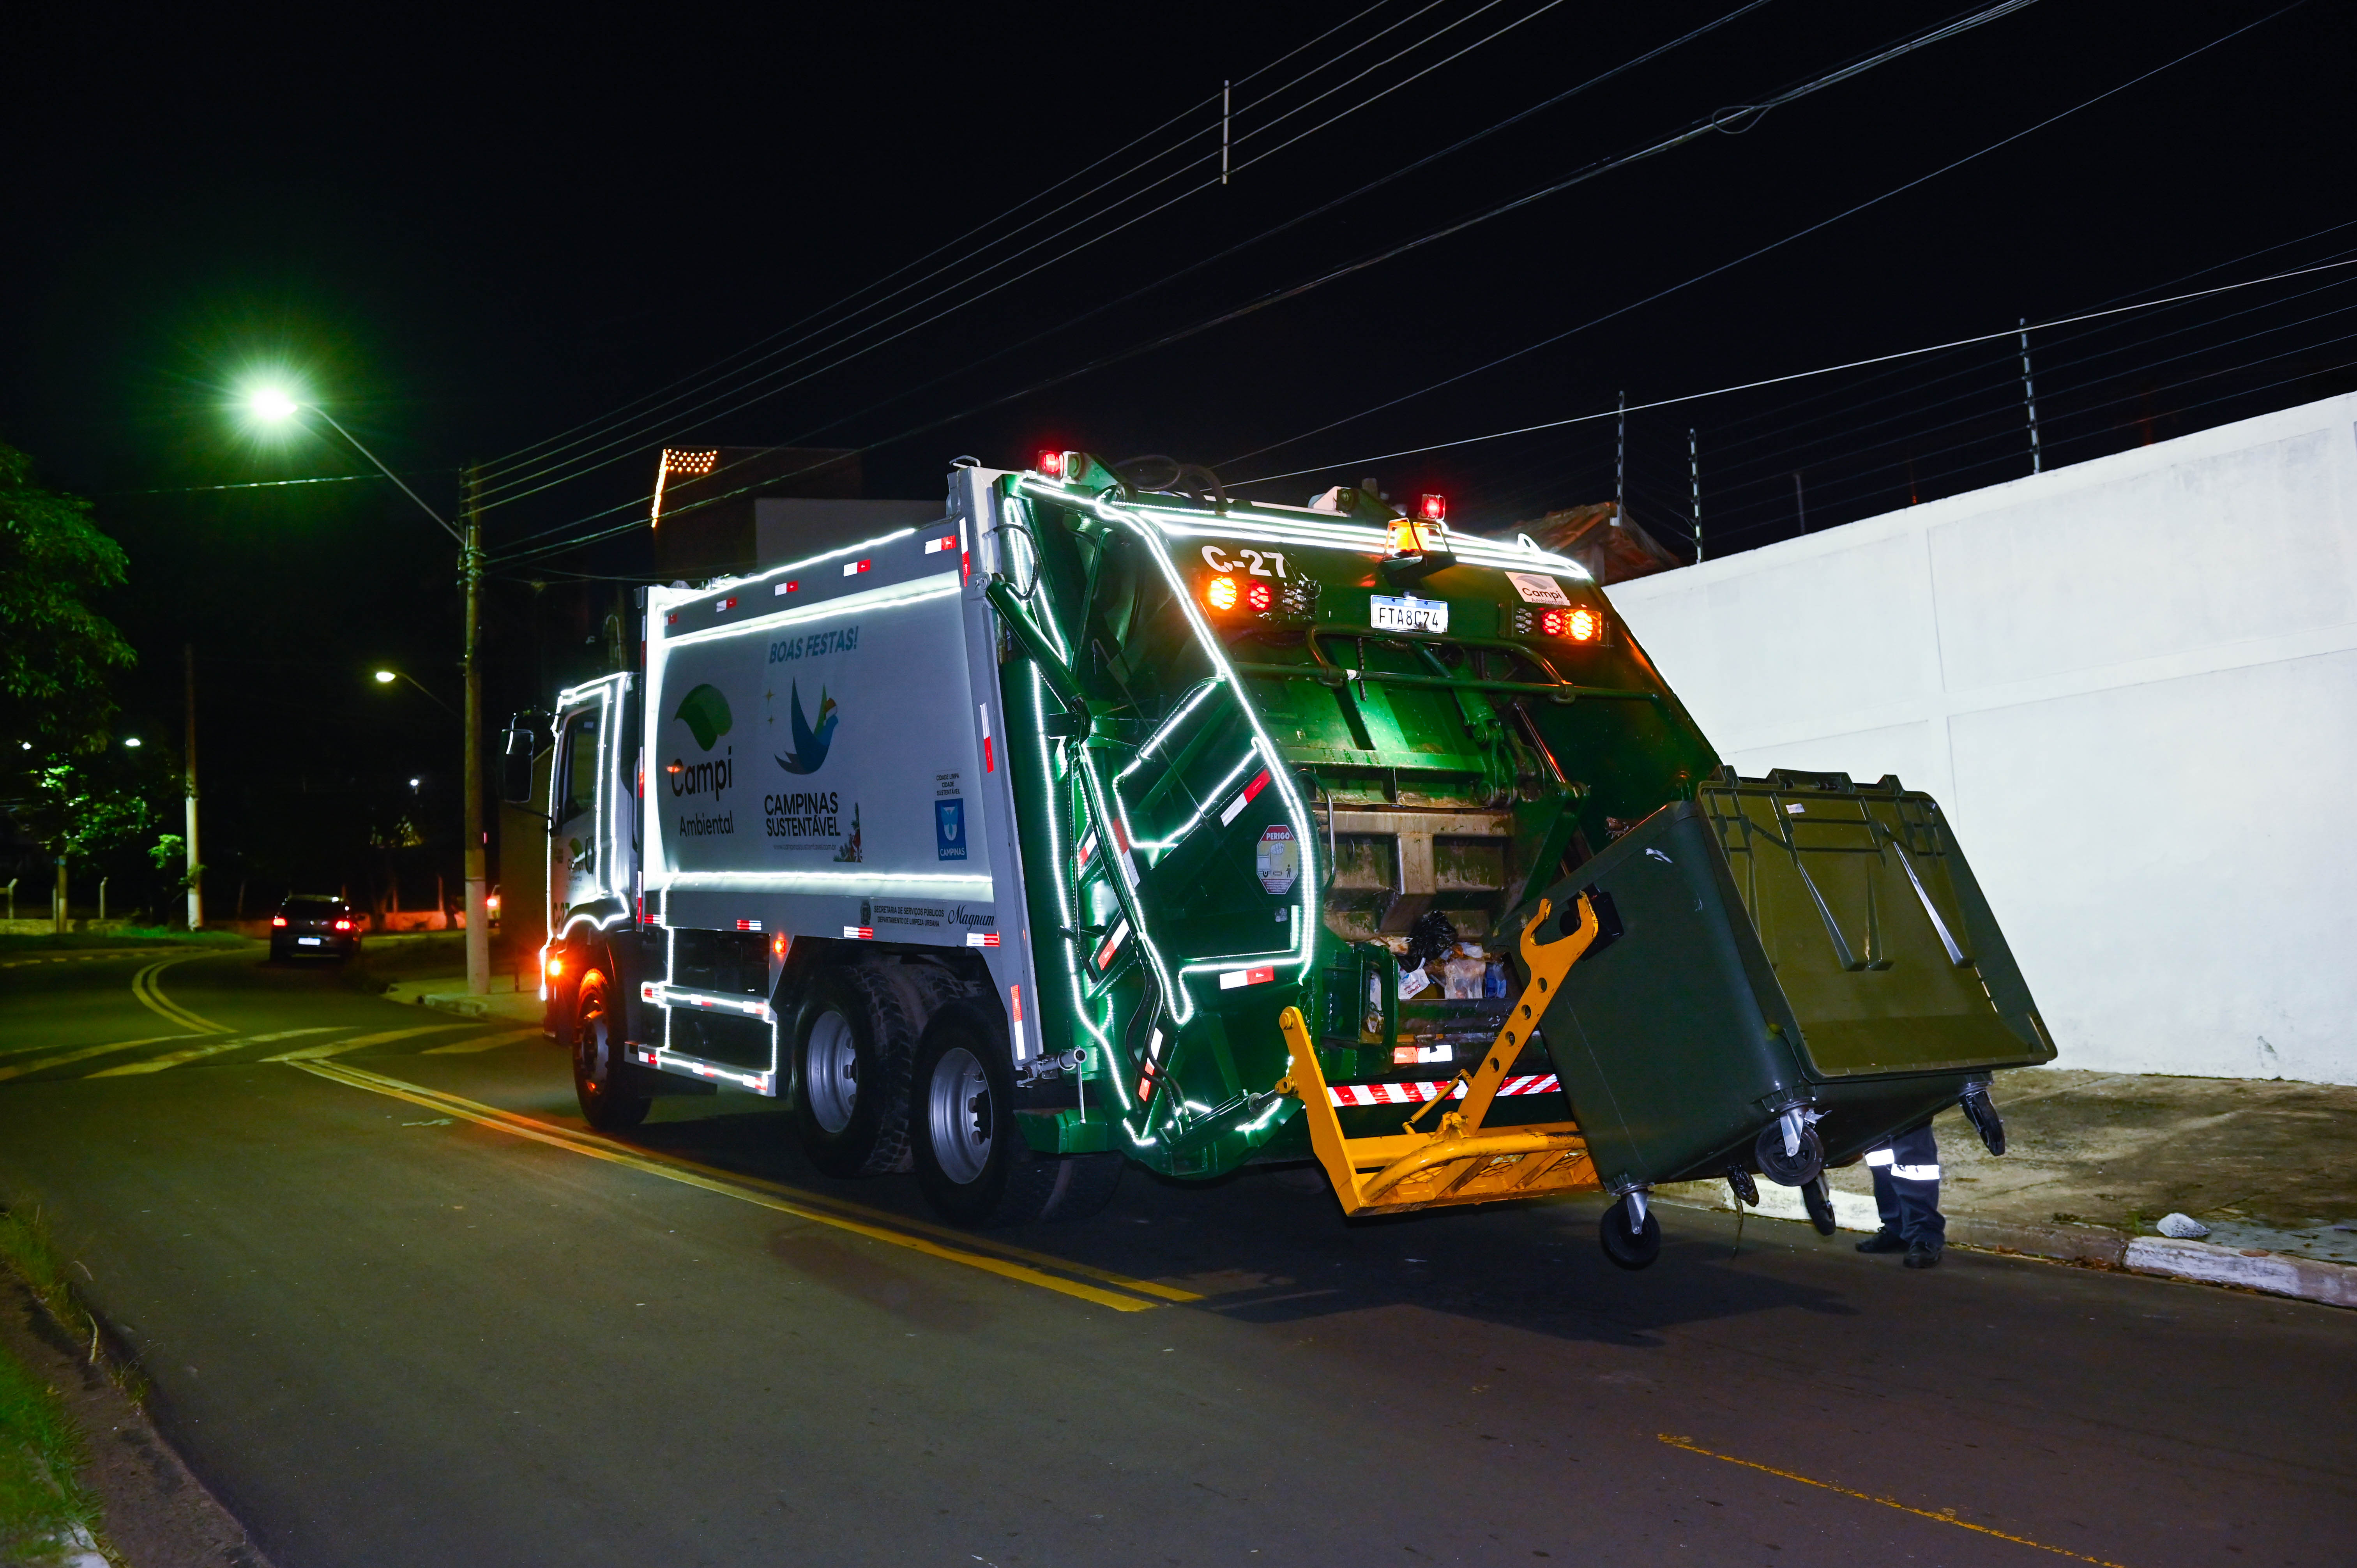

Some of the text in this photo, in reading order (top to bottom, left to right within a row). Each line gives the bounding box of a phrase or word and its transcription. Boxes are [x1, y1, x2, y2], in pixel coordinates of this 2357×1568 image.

[1201, 545, 1287, 578] C-27
[1522, 587, 1562, 601] Campi
[1379, 607, 1438, 628] FTA8C74
[769, 626, 859, 664] BOAS FESTAS!
[671, 746, 732, 802] Campi
[764, 792, 838, 816] CAMPINAS
[680, 810, 734, 837] Ambiental
[766, 815, 841, 837] SUSTENTÁVEL
[940, 847, 965, 856] CAMPINAS
[874, 906, 897, 914] SECRETARIA
[904, 907, 923, 916] SERVIÇOS
[924, 907, 944, 917] PÚBLICOS
[877, 916, 904, 924] DEPARTAMENTO
[948, 905, 995, 931] Magnum
